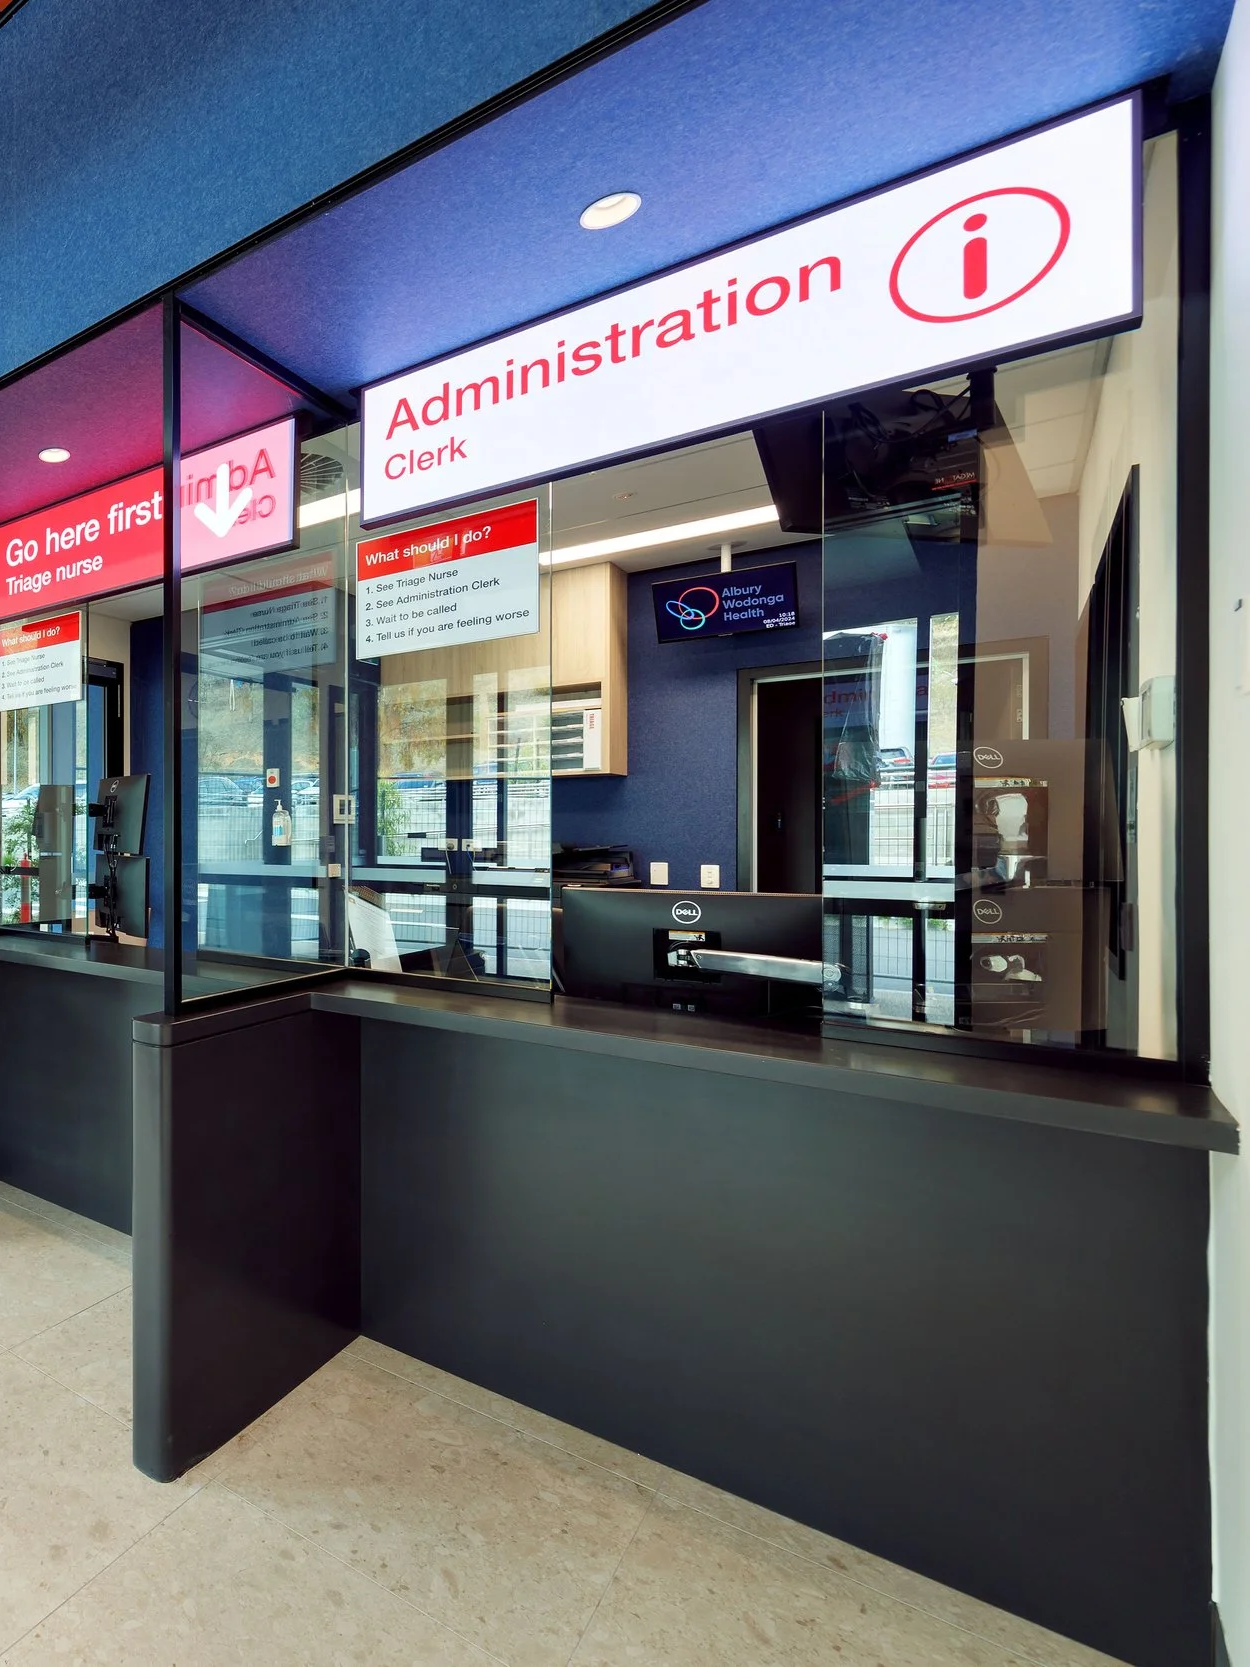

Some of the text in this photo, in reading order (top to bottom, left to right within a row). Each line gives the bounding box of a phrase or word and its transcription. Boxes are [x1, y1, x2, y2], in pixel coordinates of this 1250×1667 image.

[385, 256, 841, 441] Administration
[384, 436, 468, 480] Clerk
[6, 490, 163, 567] Go here first
[365, 525, 491, 566] What should I do?
[6, 555, 103, 596] Triage nurse
[365, 569, 458, 594] 1. See Triage Nurse
[365, 577, 500, 611] 2. See Administration Clerk
[721, 584, 762, 598] Albury
[722, 593, 784, 610] Wodonga
[365, 602, 457, 627] 3. Wait to be called
[365, 609, 530, 643] 4. Tell us if you are feeling worse
[723, 608, 765, 622] Health
[1, 637, 19, 648] What
[19, 631, 42, 645] should
[46, 626, 61, 637] do?
[50, 661, 64, 669] Clerk
[43, 685, 61, 694] feeling
[977, 753, 1000, 761] DELL
[977, 907, 1000, 915] DELL
